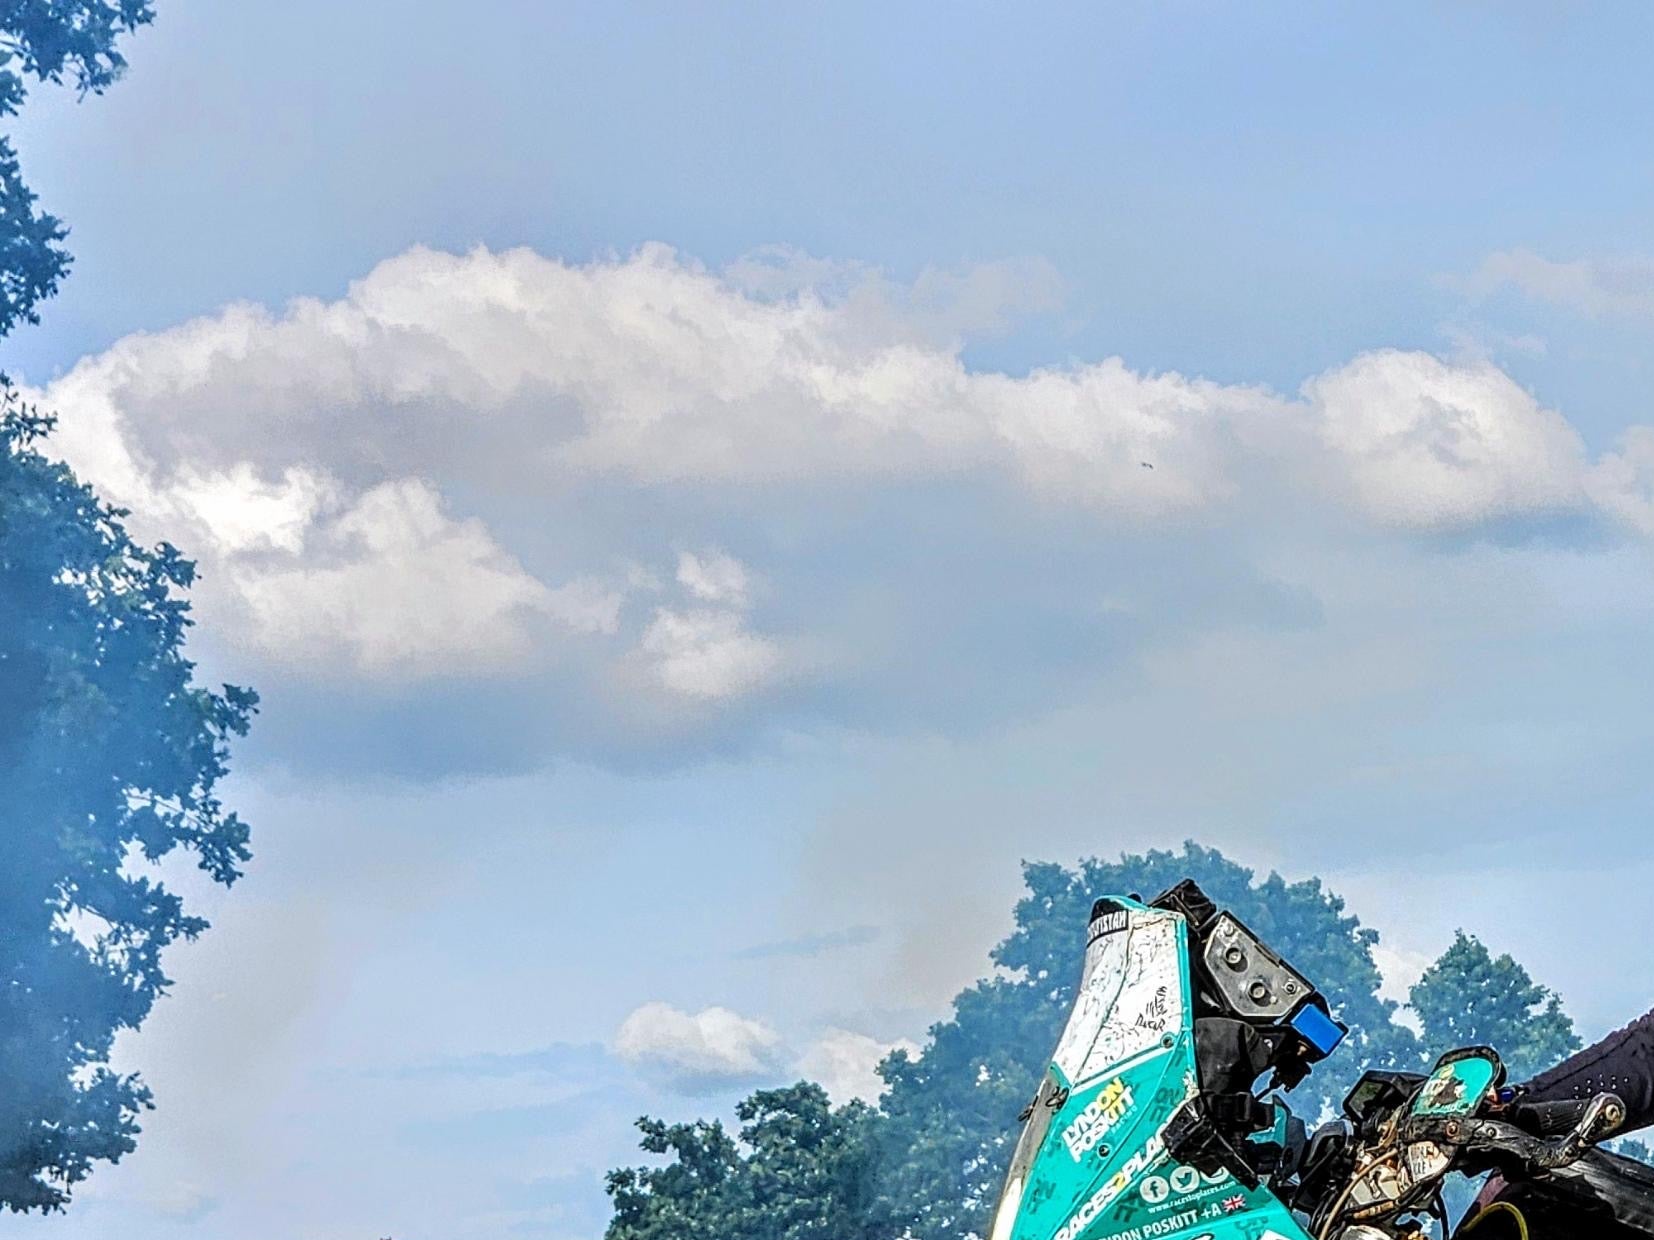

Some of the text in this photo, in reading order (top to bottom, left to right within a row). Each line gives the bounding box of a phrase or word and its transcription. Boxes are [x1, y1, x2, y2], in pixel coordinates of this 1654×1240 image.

[1062, 1076, 1125, 1147] LYNDON
[1069, 1086, 1135, 1163] POSKITT
[1110, 1105, 1138, 1134] RACING
[1143, 1209, 1197, 1239] POSKITT
